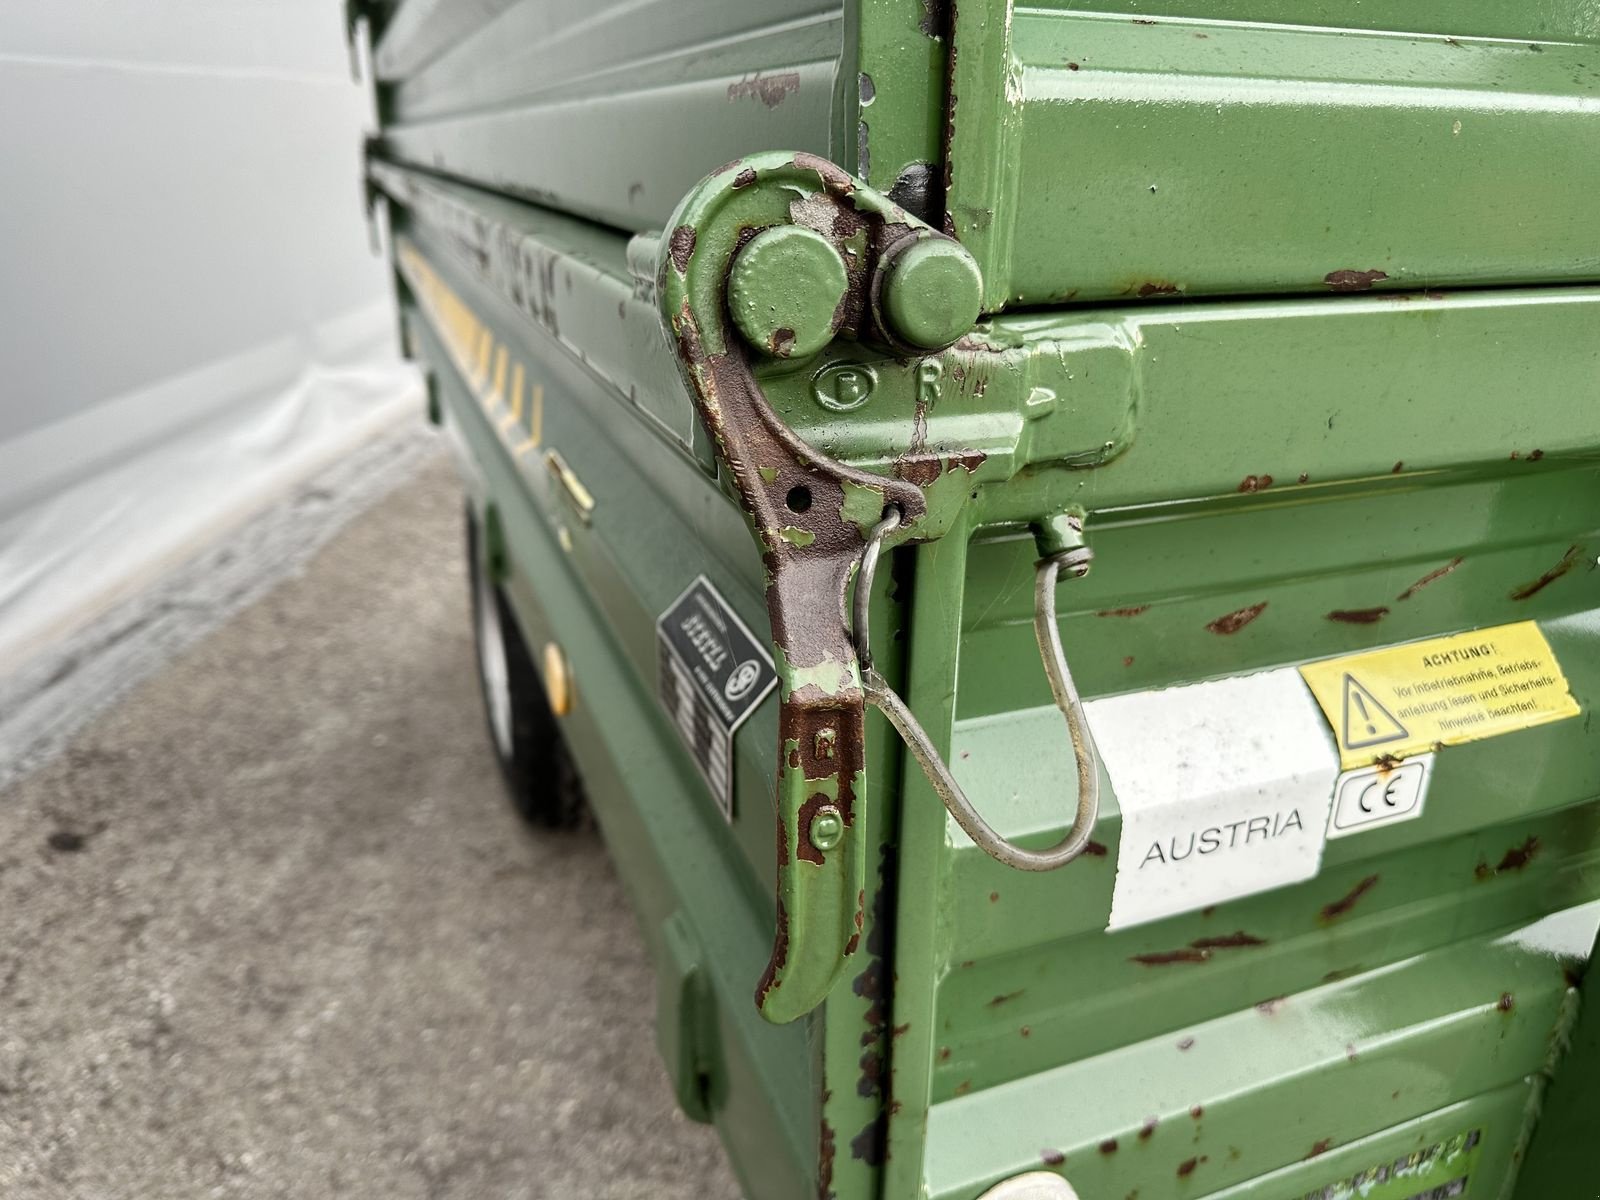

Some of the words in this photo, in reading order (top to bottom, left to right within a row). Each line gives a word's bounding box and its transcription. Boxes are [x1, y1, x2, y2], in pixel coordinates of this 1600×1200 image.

[914, 357, 942, 401] R
[1422, 642, 1497, 669] ACHTUNG!
[1393, 684, 1413, 699] Vor
[1496, 659, 1543, 677] Betriebs-
[1397, 699, 1448, 721] anleitung
[1447, 692, 1478, 708] lesen
[1479, 686, 1498, 701] und
[1498, 674, 1558, 697] Sicherheits-
[1438, 712, 1486, 732] hinweise
[1487, 697, 1538, 721] beachten!
[1138, 807, 1304, 870] AUSTRIA
